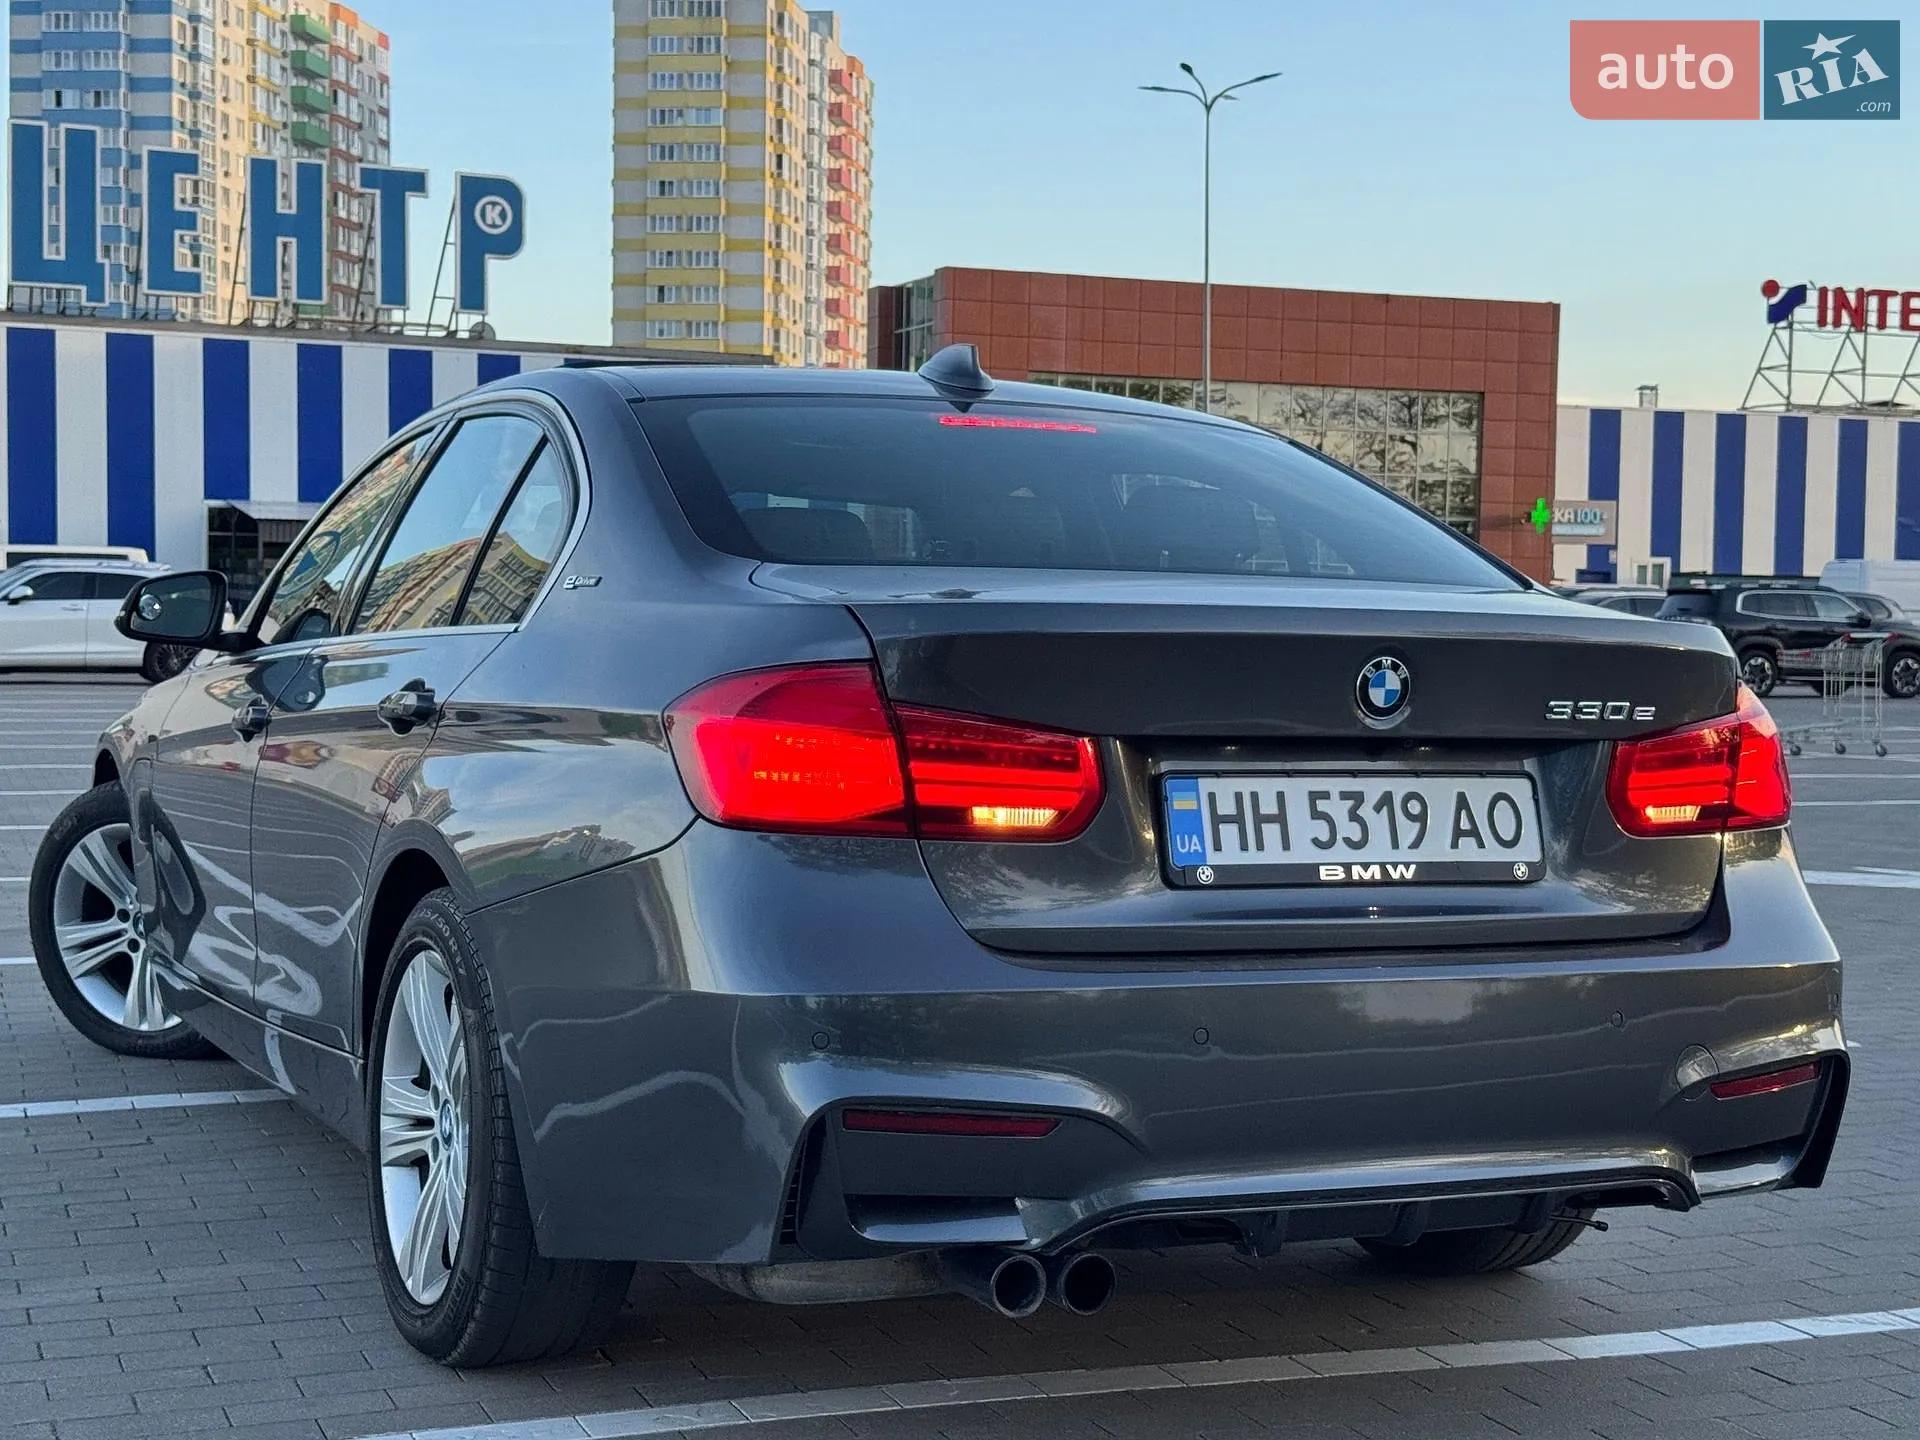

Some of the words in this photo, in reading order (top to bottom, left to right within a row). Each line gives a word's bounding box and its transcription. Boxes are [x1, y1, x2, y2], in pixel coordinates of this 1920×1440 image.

[8, 119, 526, 316] ЦЕНТР
[1817, 286, 1920, 332] INTE
[1545, 701, 1656, 720] 330e
[1207, 791, 1291, 852] HH
[1308, 791, 1429, 850] 5319
[1450, 791, 1523, 850] AO
[1176, 834, 1202, 853] UA
[1319, 864, 1417, 880] BMW
